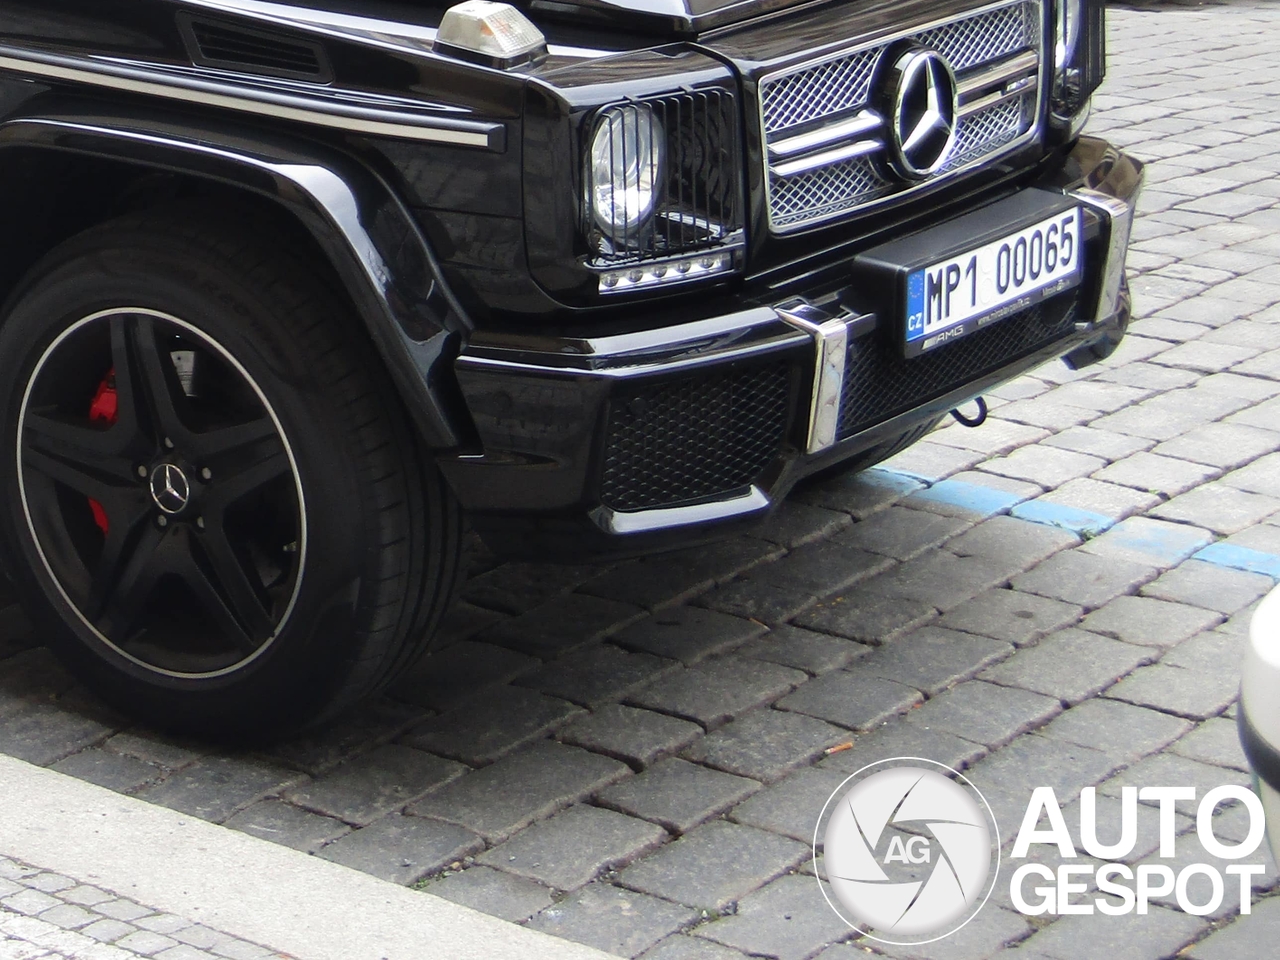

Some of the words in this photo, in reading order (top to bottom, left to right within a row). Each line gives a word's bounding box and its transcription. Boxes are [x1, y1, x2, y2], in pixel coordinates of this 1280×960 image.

[926, 254, 977, 326] MP1
[996, 214, 1074, 295] 00065
[908, 311, 922, 331] CZ
[935, 324, 964, 344] AMG
